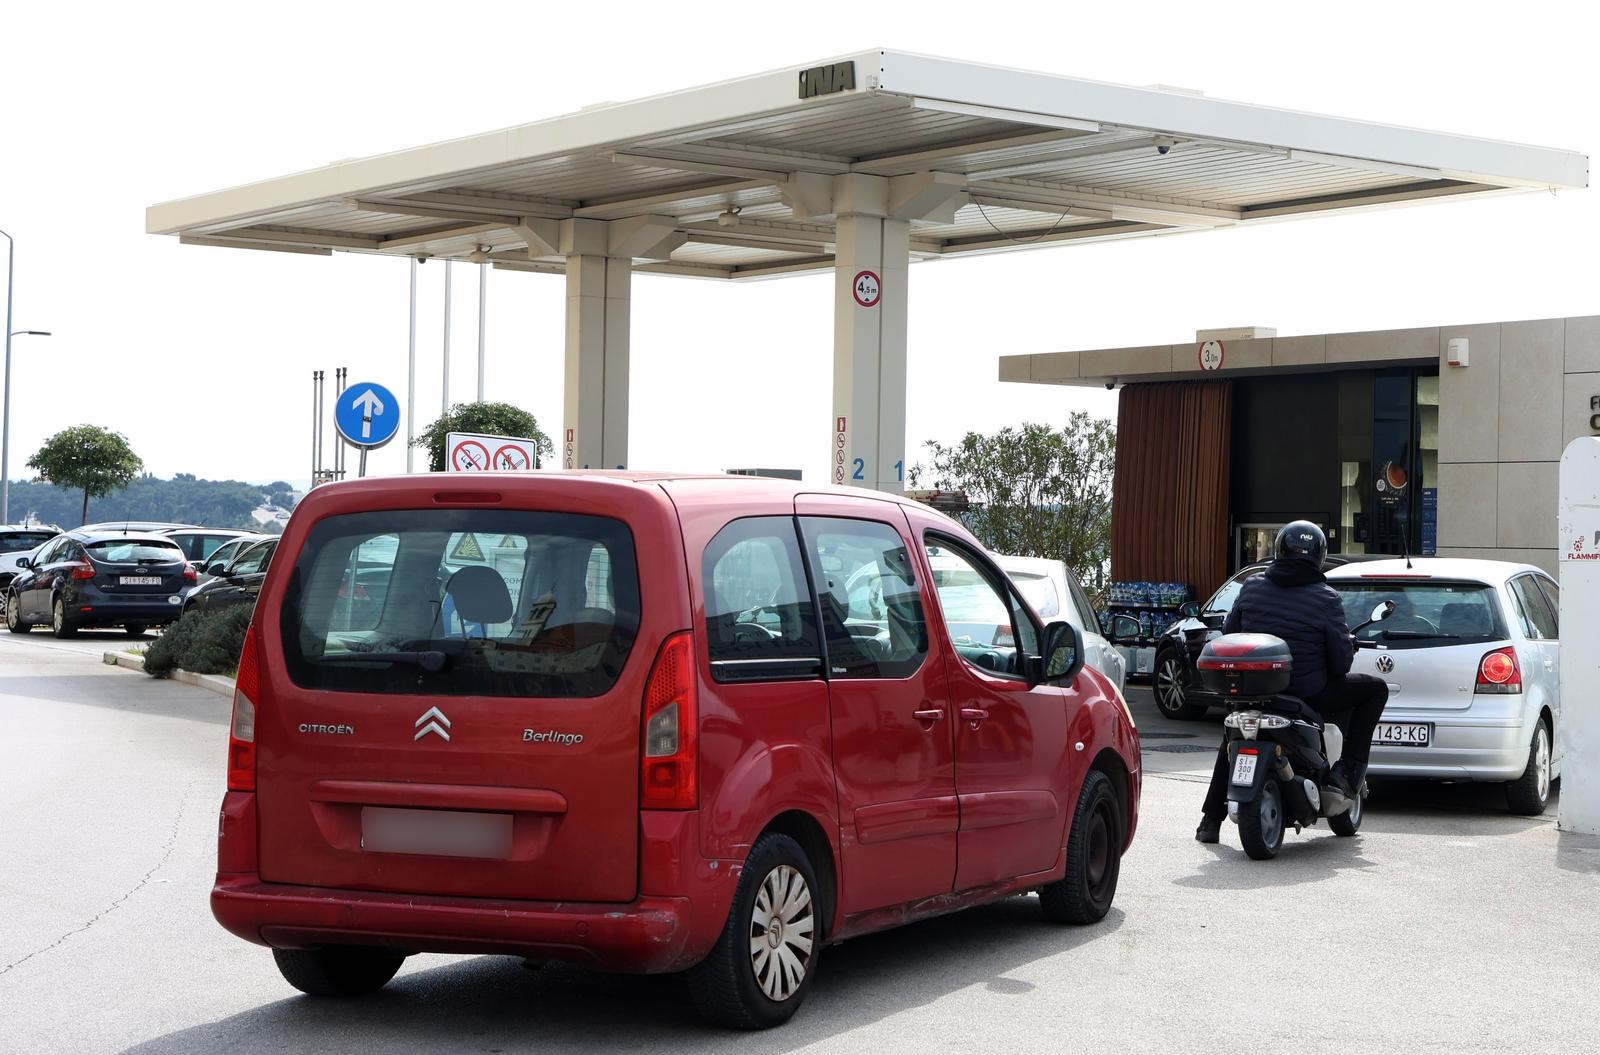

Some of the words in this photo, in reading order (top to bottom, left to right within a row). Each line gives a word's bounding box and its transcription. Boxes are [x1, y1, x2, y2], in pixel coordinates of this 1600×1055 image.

[852, 457, 865, 480] 2
[894, 460, 903, 481] 1
[298, 723, 354, 734] CITROËN
[522, 728, 584, 746] Berlingo
